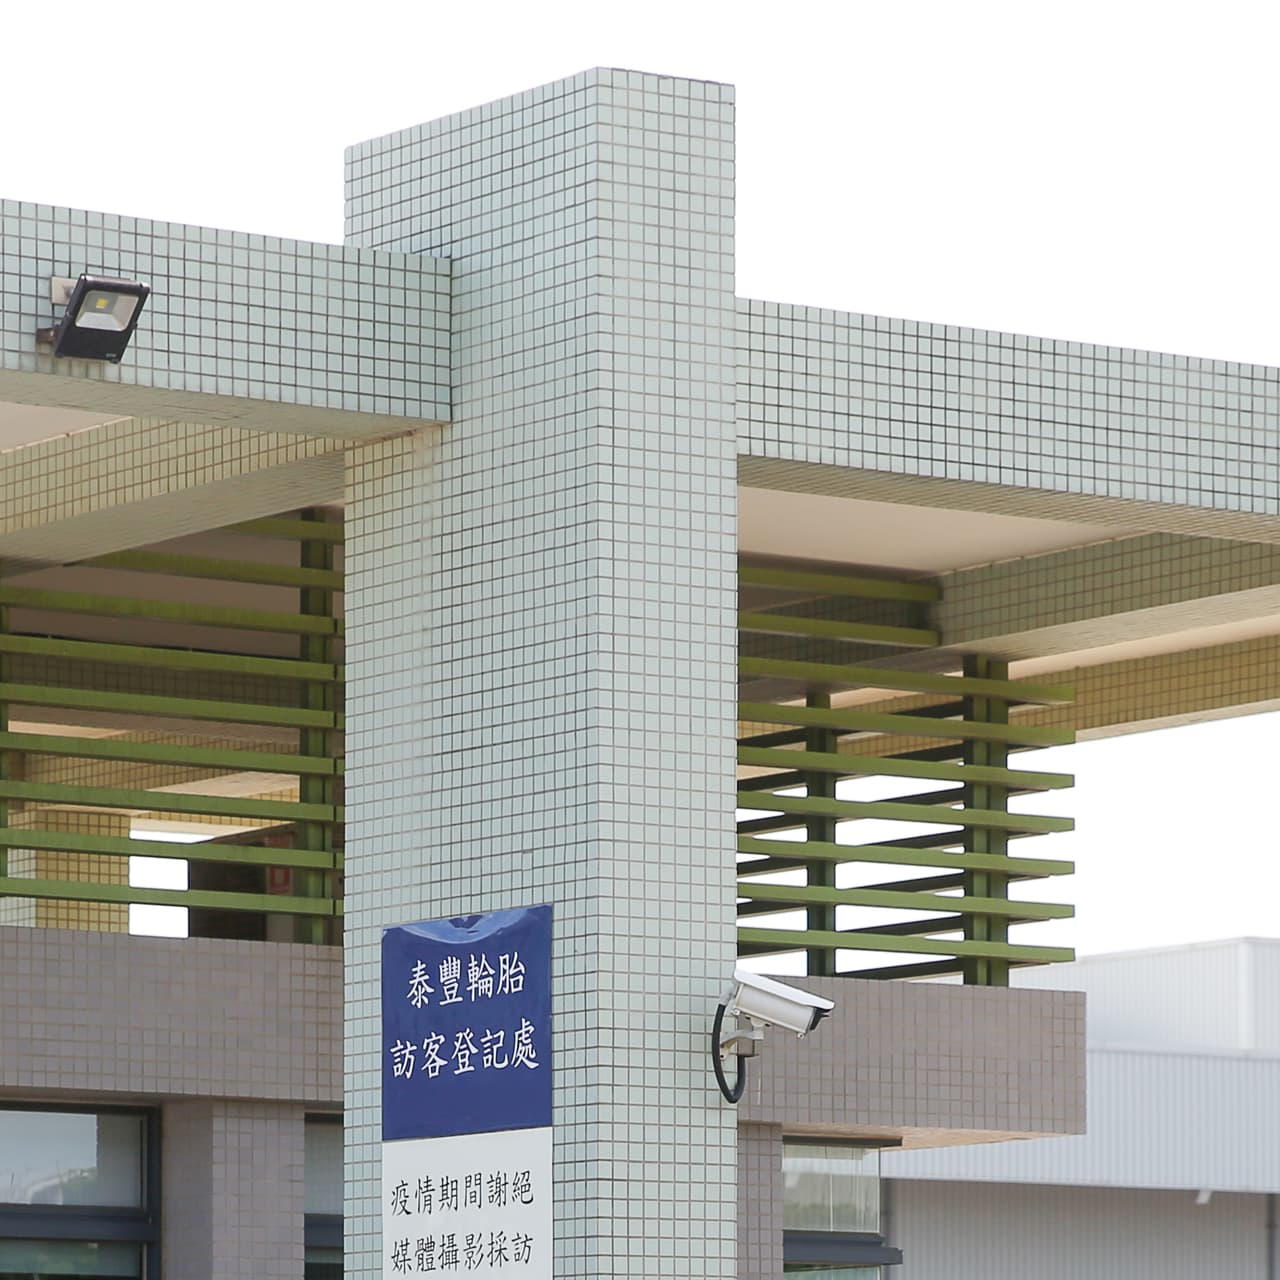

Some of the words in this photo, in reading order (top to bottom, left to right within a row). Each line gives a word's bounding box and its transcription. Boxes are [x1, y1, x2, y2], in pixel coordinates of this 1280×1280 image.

[406, 951, 526, 1009] 泰豐輪胎
[389, 1017, 540, 1080] 訪客登記處
[390, 1169, 535, 1217] 疫情期間謝絕
[390, 1230, 534, 1276] 媒體攝影採訪
